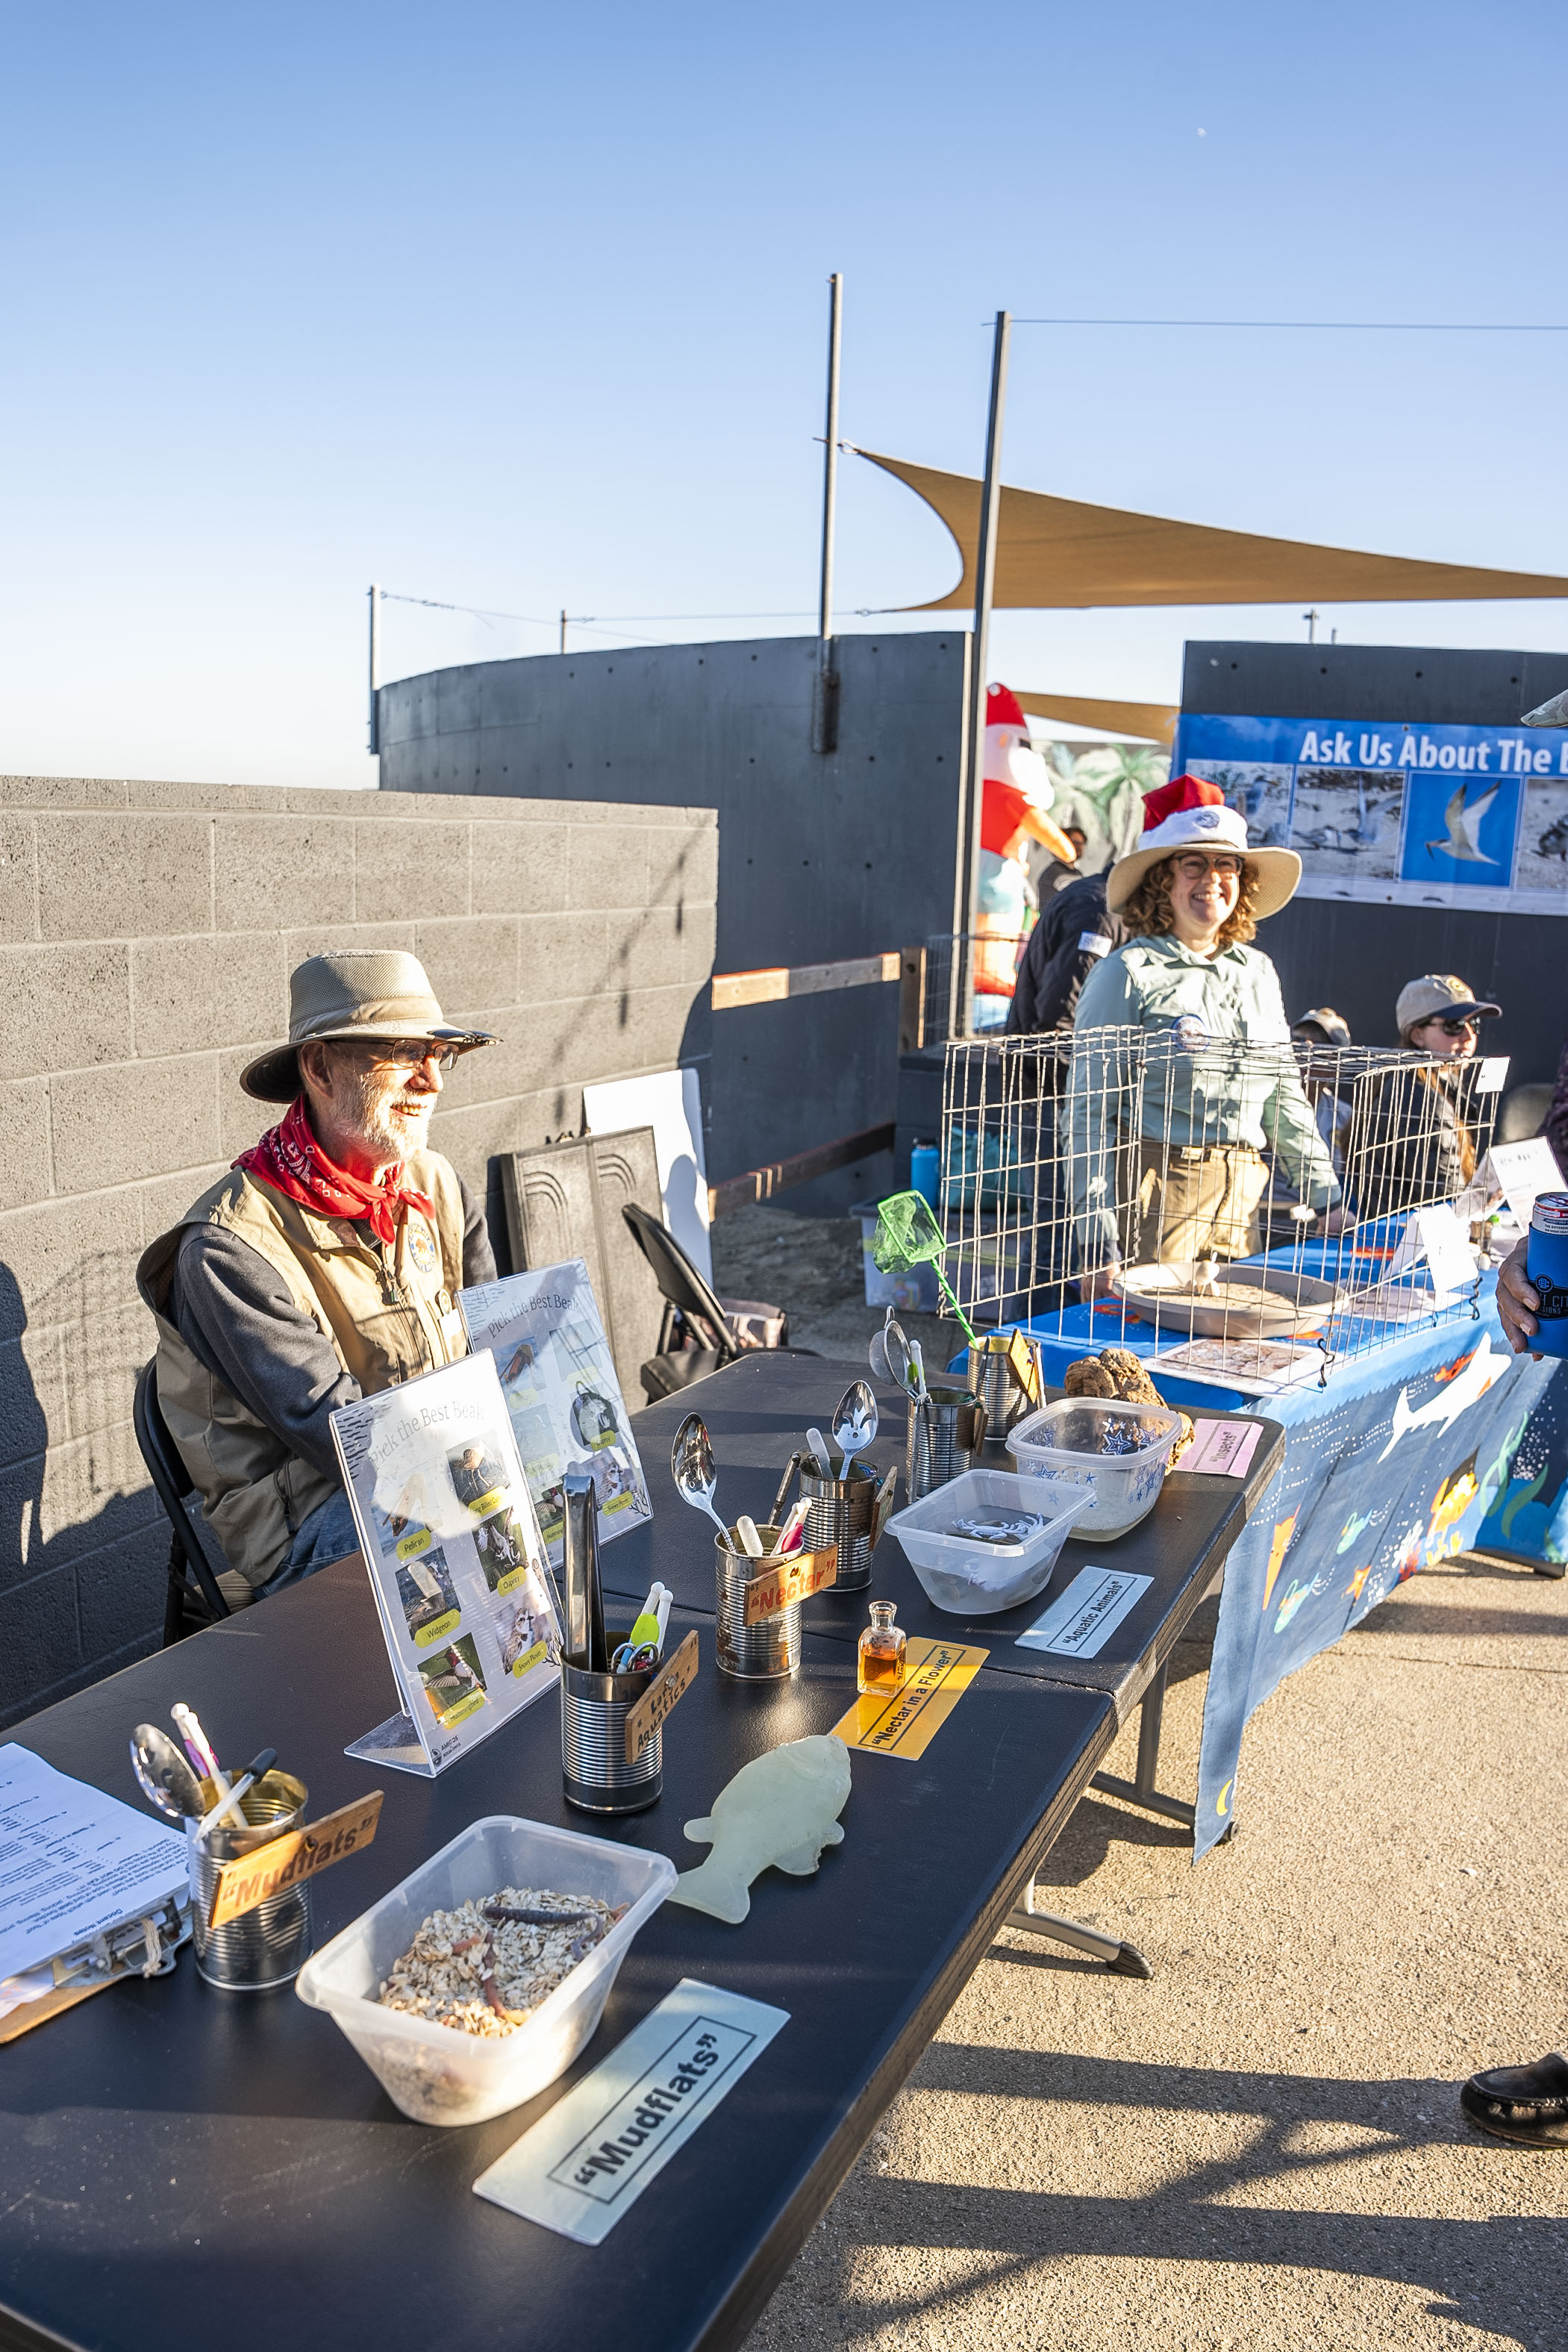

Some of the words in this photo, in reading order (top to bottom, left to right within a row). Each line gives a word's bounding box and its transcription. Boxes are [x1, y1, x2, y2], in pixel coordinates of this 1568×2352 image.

[1299, 730, 1352, 764] Ask
[1358, 733, 1393, 767] Us
[1397, 734, 1491, 772] About
[1496, 739, 1552, 775] The
[487, 1311, 511, 1339] Pick
[510, 1302, 528, 1320] the
[528, 1294, 552, 1311] Best
[553, 1294, 580, 1314] Beak
[396, 1417, 422, 1443] the
[419, 1403, 450, 1426] Best
[404, 1537, 425, 1552] Pelican
[503, 1576, 520, 1590] Osprey
[426, 1619, 452, 1640] Widgeon
[518, 1657, 531, 1671] Snowy
[528, 1648, 543, 1663] Plover
[902, 1694, 922, 1709] in
[915, 1685, 928, 1694] a
